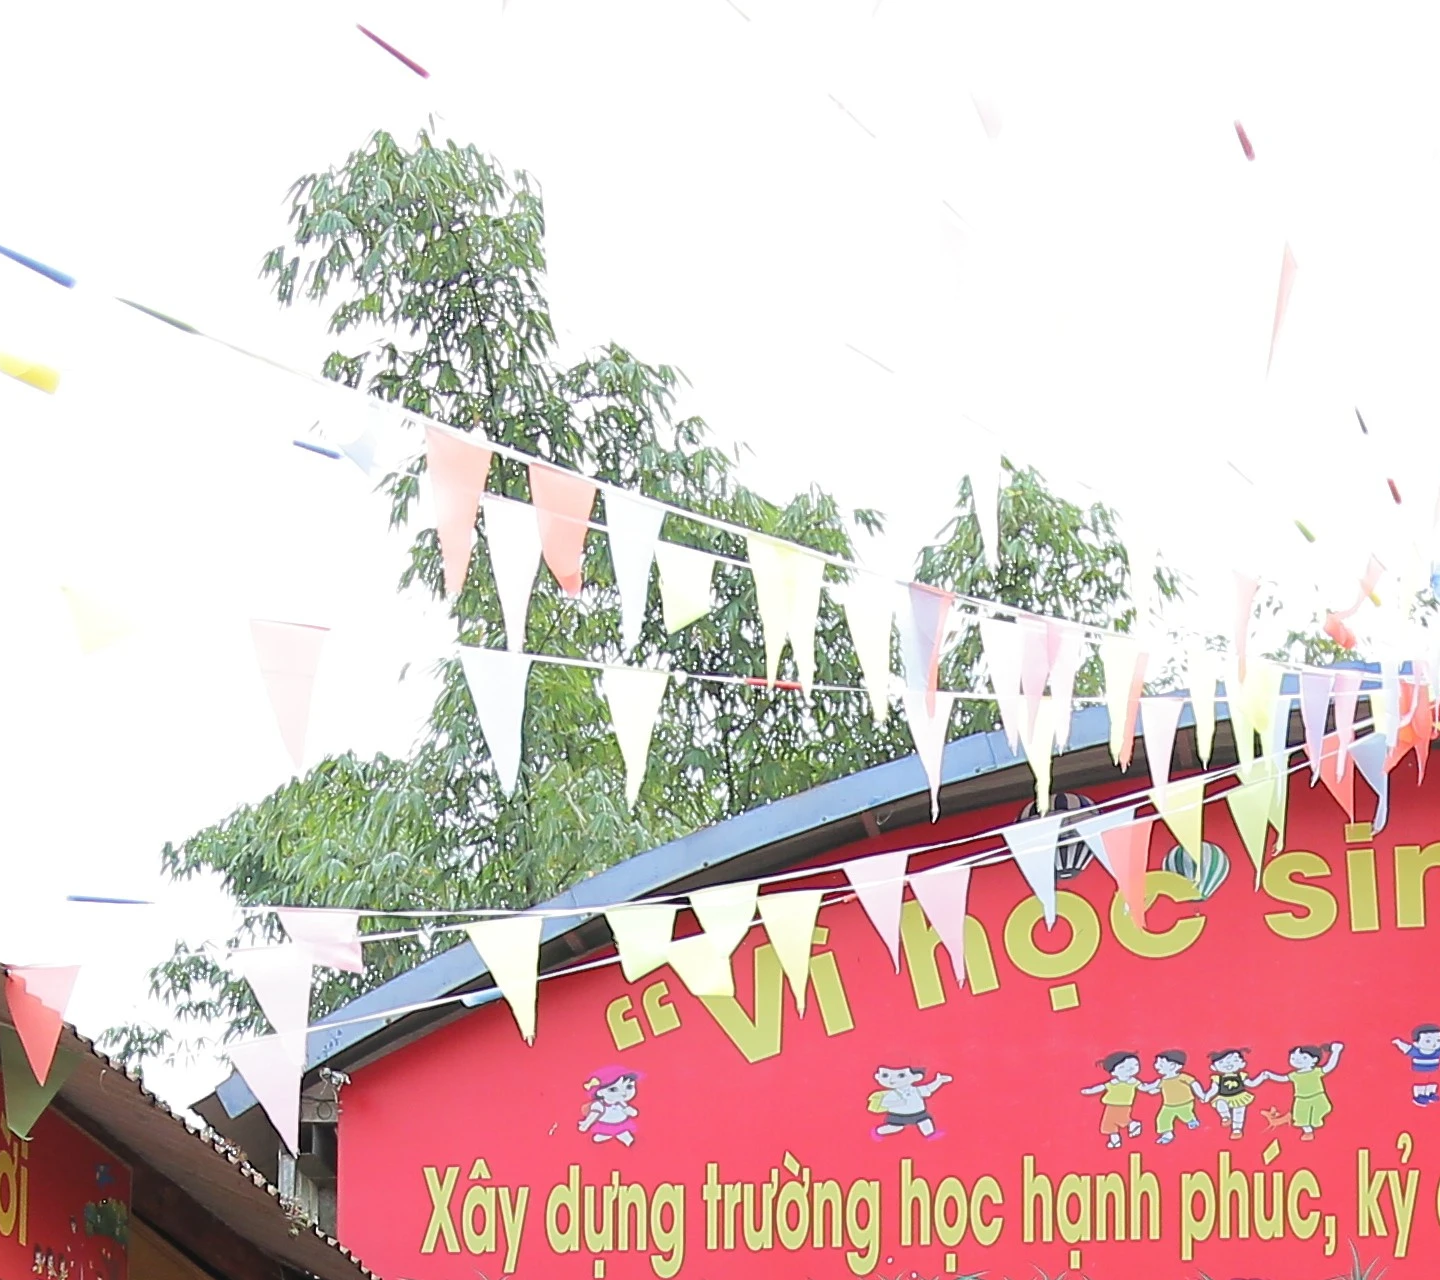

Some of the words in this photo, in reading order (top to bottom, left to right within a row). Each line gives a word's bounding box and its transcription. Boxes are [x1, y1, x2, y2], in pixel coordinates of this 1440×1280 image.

[900, 866, 1208, 1012] học
[420, 1157, 529, 1274] Xây
[544, 1163, 686, 1280] dựng
[702, 1151, 881, 1276] trường
[900, 1157, 1005, 1273] học
[1021, 1152, 1162, 1271] hạnh
[1180, 1138, 1338, 1262] phúc,
[1357, 1132, 1421, 1258] kỷ
